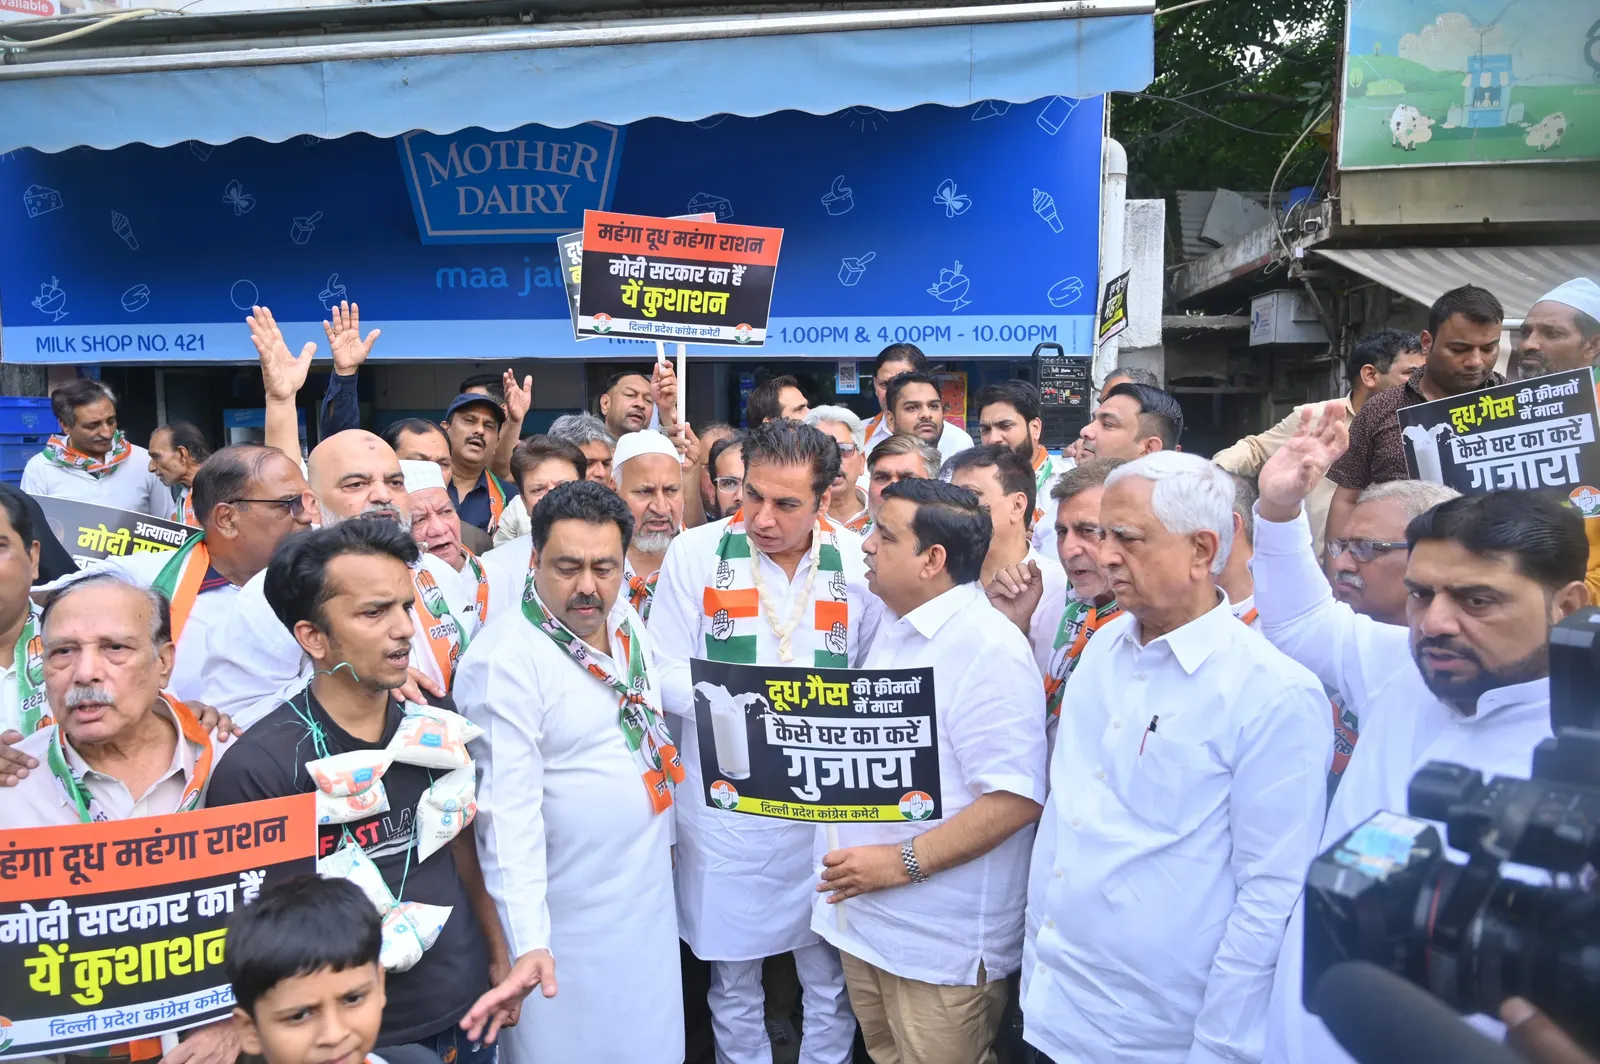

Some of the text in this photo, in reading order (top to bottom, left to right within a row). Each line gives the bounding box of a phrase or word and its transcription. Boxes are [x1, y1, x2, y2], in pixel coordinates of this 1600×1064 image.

[0, 0, 49, 13] vailable
[421, 140, 598, 187] MOTHER
[456, 184, 572, 216] DAIRY
[597, 220, 765, 254] महंगा दूध महंगा राशन
[436, 266, 509, 290] maa
[517, 256, 563, 297] jai
[609, 255, 647, 279] मोदी
[649, 262, 707, 284] सरकार
[708, 269, 731, 285] का
[620, 279, 730, 318] यें कुशाशन
[36, 334, 204, 353] MILK SHOP NO. 421
[629, 321, 721, 337] दिल्ली प्रदेश कांग्रेस कमेटी
[780, 326, 848, 343] 1.00PM
[855, 326, 871, 343] &
[877, 326, 950, 343] 4.00PM
[972, 325, 1057, 342] 10.00PM
[1516, 388, 1534, 404] की
[1533, 402, 1564, 417] मारा
[1457, 417, 1582, 459] कैसे घर का करें
[77, 523, 131, 556] मोदी
[134, 521, 187, 546] अत्याचारी
[851, 677, 871, 695] की
[869, 699, 904, 714] मारा
[772, 716, 922, 745] कैसे घर का करें
[782, 748, 916, 801] गुजारा
[383, 803, 418, 838] LA
[761, 801, 879, 819] दिल्ली प्रदेश कांग्रेस कमेटी
[0, 815, 288, 885] हंगा दूध महंगा राशन
[0, 899, 72, 944] मोदी
[75, 891, 191, 936] सरकार
[194, 882, 237, 917] का
[24, 943, 69, 996] यें
[49, 986, 234, 1037] दिल्ली प्रदेश कांग्रेस कमेटी
